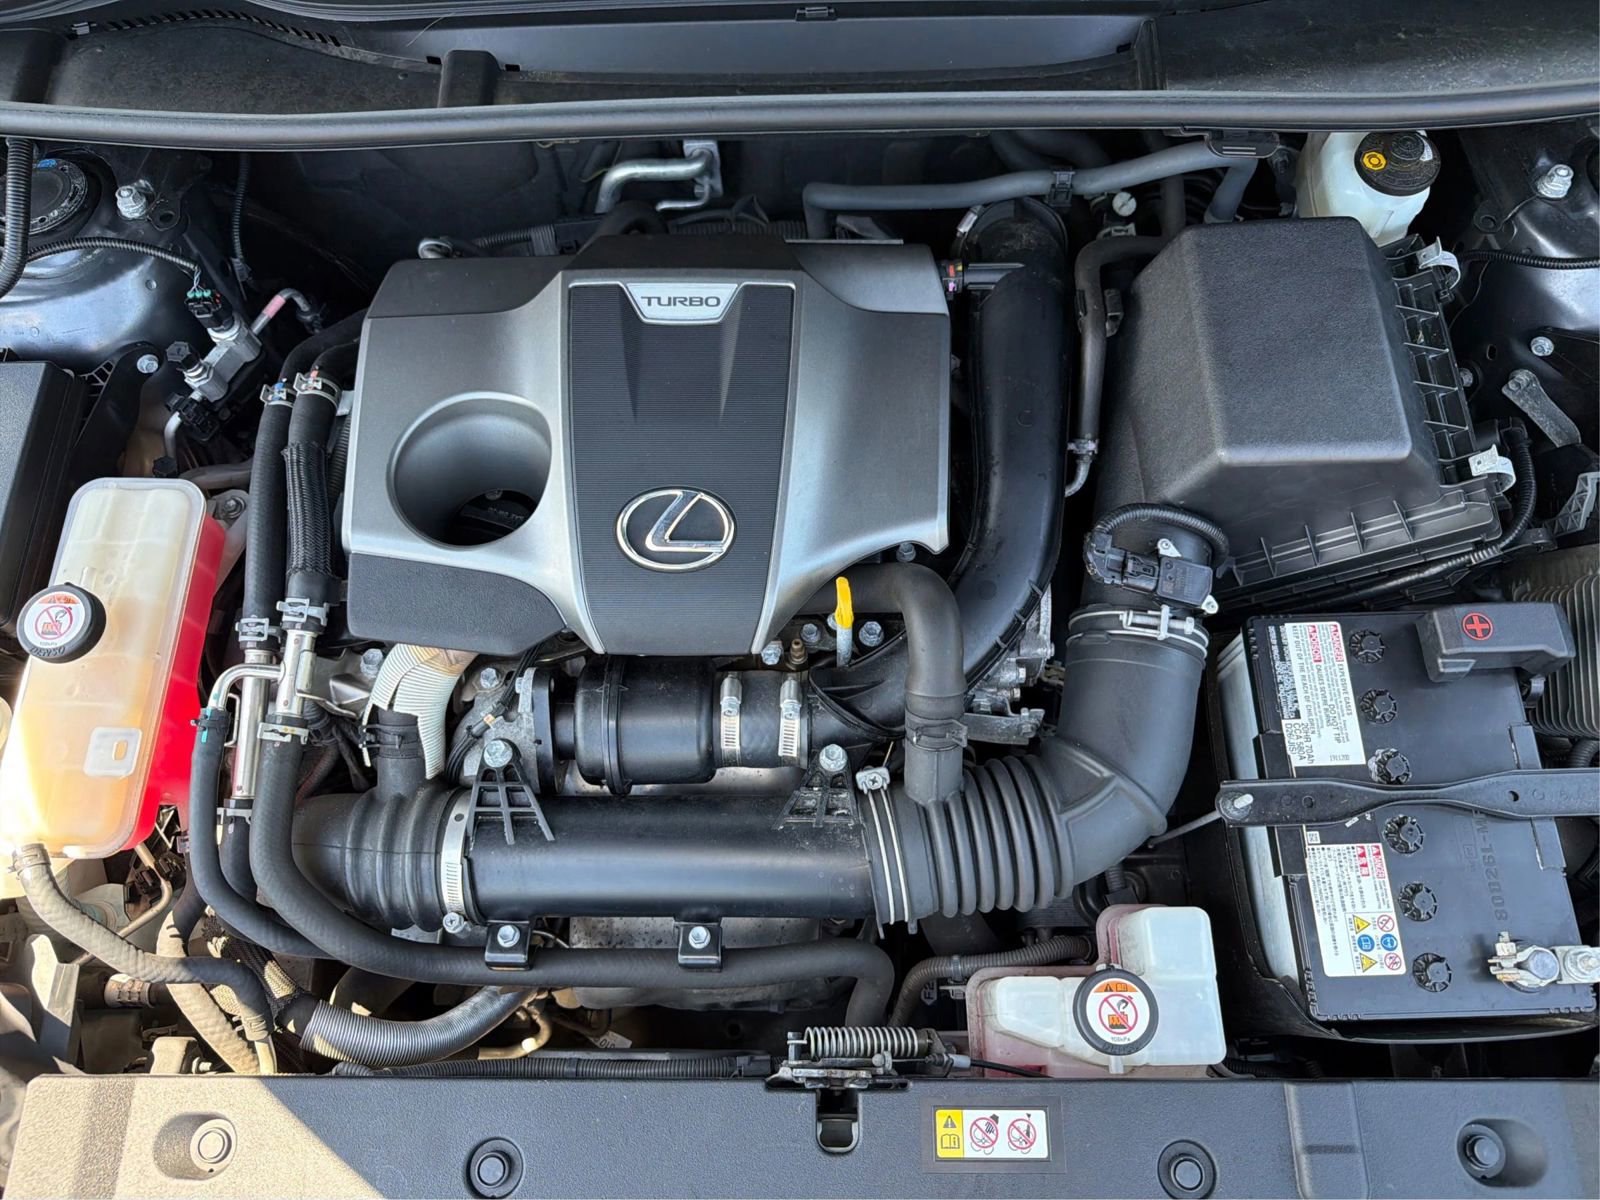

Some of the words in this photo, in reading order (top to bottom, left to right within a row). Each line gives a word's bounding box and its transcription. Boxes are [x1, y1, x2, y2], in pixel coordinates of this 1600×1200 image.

[640, 295, 722, 308] TURBO
[1292, 626, 1300, 639] KEEP
[29, 645, 66, 657] DENSO
[1309, 632, 1322, 660] POISON
[1332, 632, 1344, 661] DANGER
[1297, 653, 1303, 661] OF
[1298, 662, 1306, 673] THE
[1316, 664, 1325, 685] CAUSES
[1300, 674, 1309, 694] REACH
[1337, 663, 1348, 695] EXPLOSIVE
[1319, 686, 1329, 706] SEVERE
[1328, 704, 1336, 715] DO
[1343, 696, 1352, 716] GASES
[1305, 704, 1316, 735] CHILDREN
[1323, 707, 1332, 727] BURNS
[1330, 716, 1339, 731] NOT
[1293, 722, 1302, 740] CCA
[1301, 722, 1311, 742] 20HR
[1333, 733, 1341, 744] TIP
[1305, 745, 1315, 764] 70Ah
